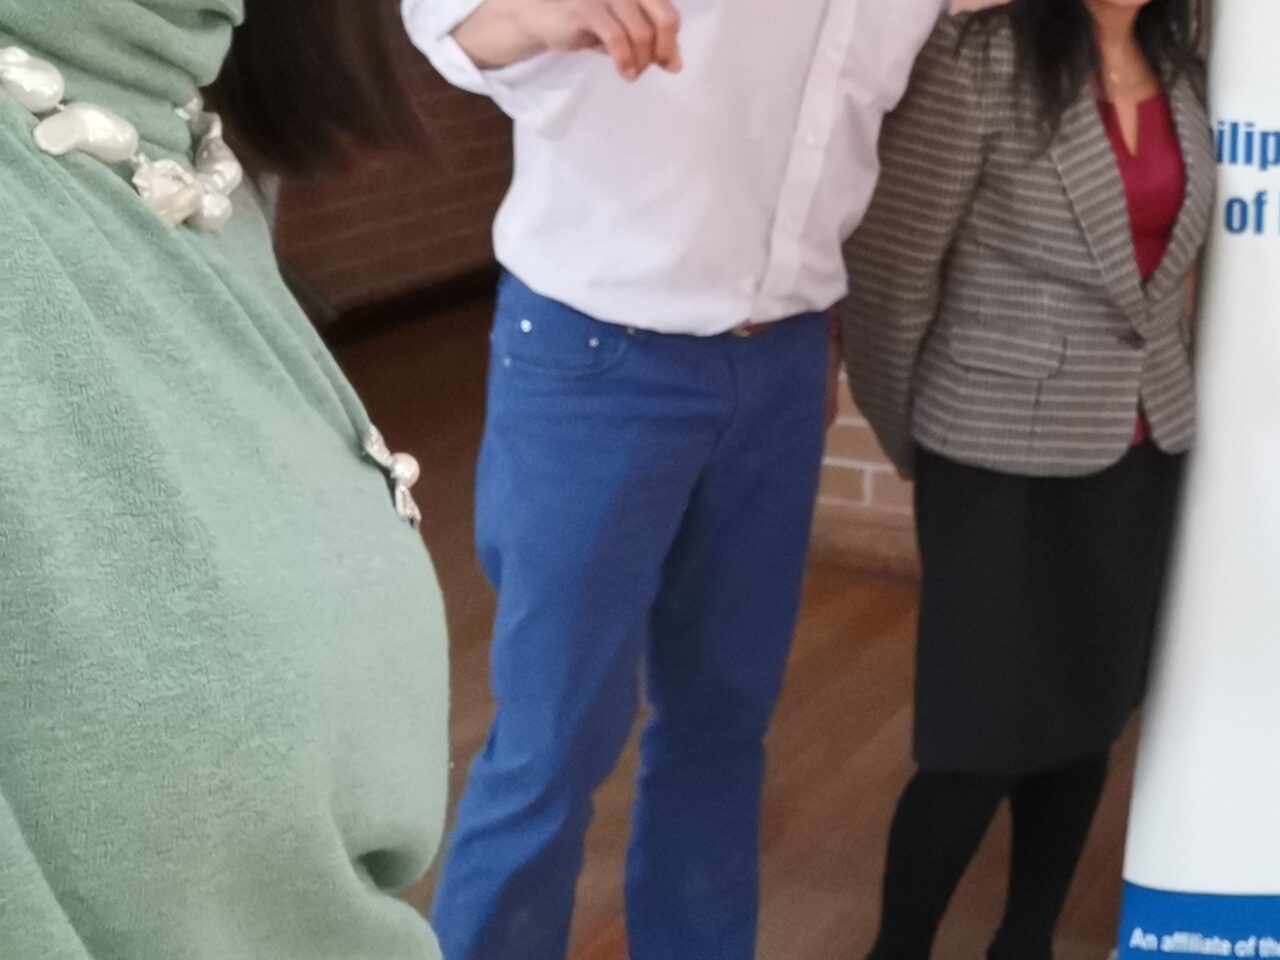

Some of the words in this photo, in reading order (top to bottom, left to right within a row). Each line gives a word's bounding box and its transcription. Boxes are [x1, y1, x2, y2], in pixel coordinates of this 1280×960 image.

[1224, 190, 1267, 235] of
[1129, 927, 1158, 951] An
[1234, 935, 1257, 958] of
